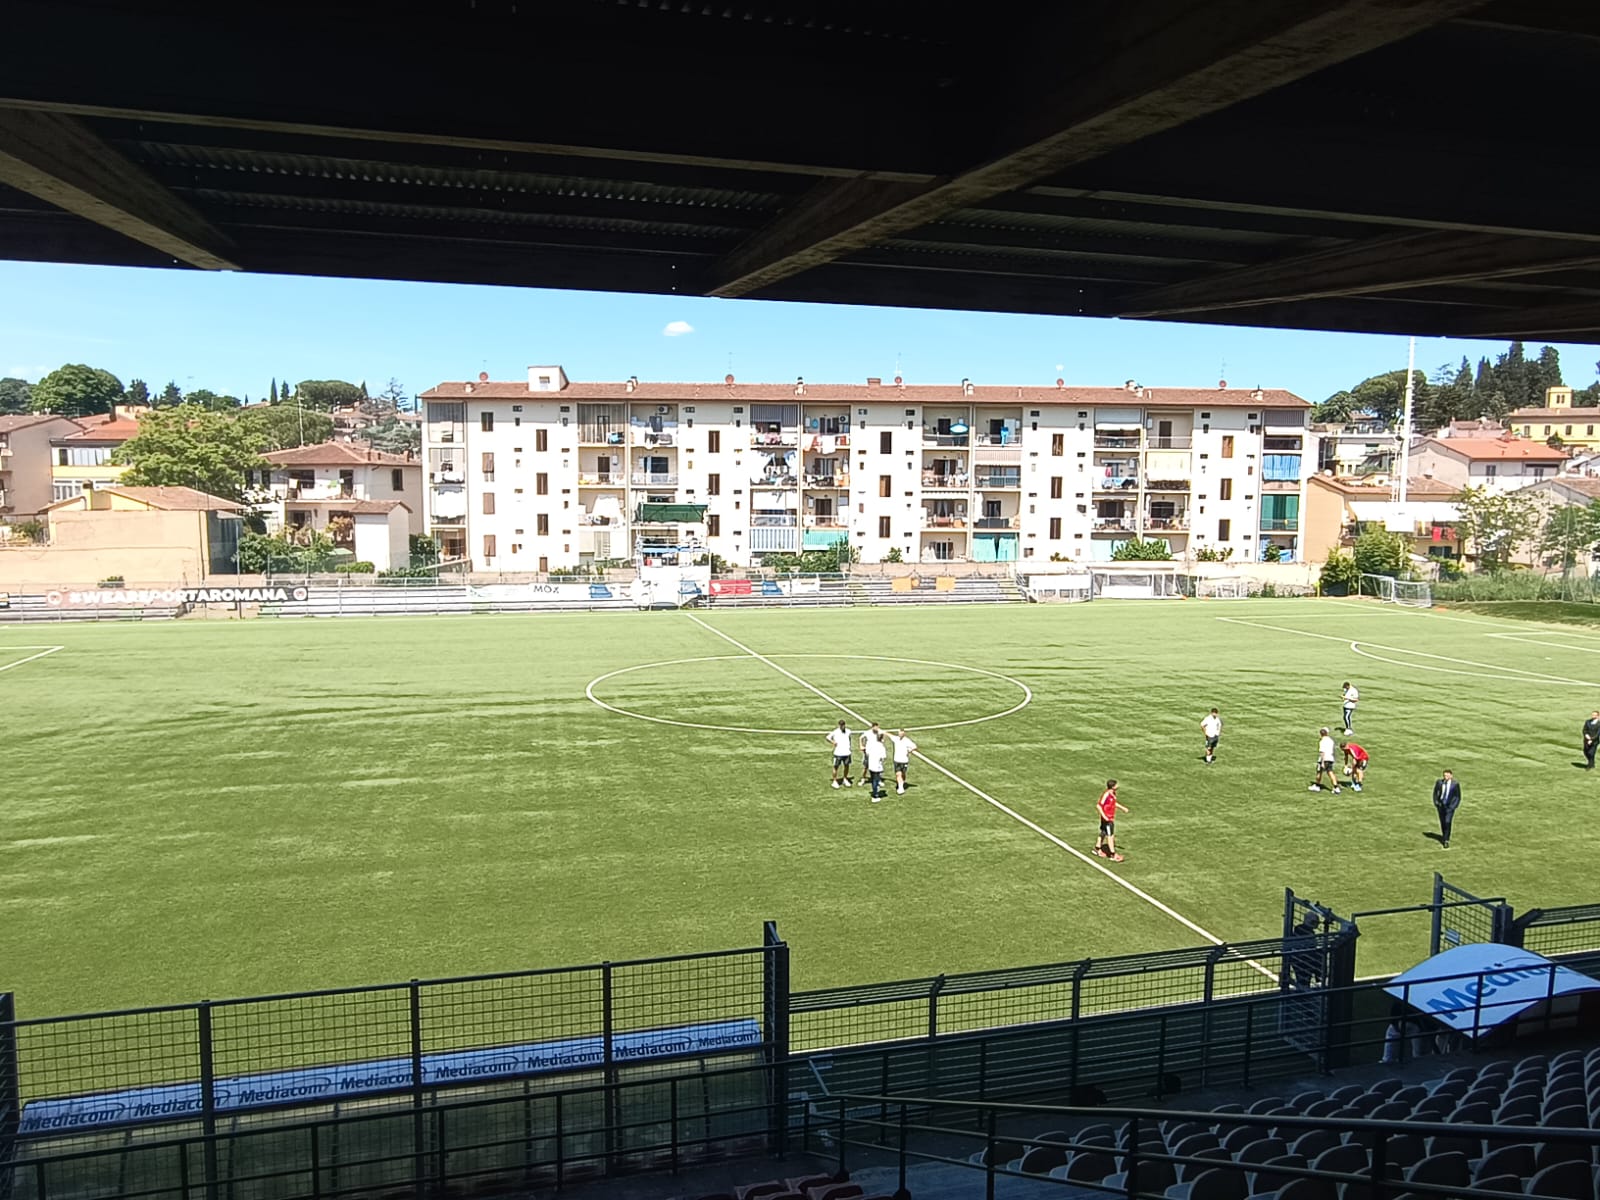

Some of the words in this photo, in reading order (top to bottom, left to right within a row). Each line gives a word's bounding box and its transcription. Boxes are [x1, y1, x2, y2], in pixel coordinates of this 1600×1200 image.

[23, 1110, 116, 1131] Mediacom
[240, 1082, 322, 1104] Mediacom
[435, 1061, 512, 1079] Mediacom
[527, 1050, 600, 1069] Mediacom
[615, 1040, 686, 1058] Mediacom
[699, 1031, 754, 1047] Mediacom
